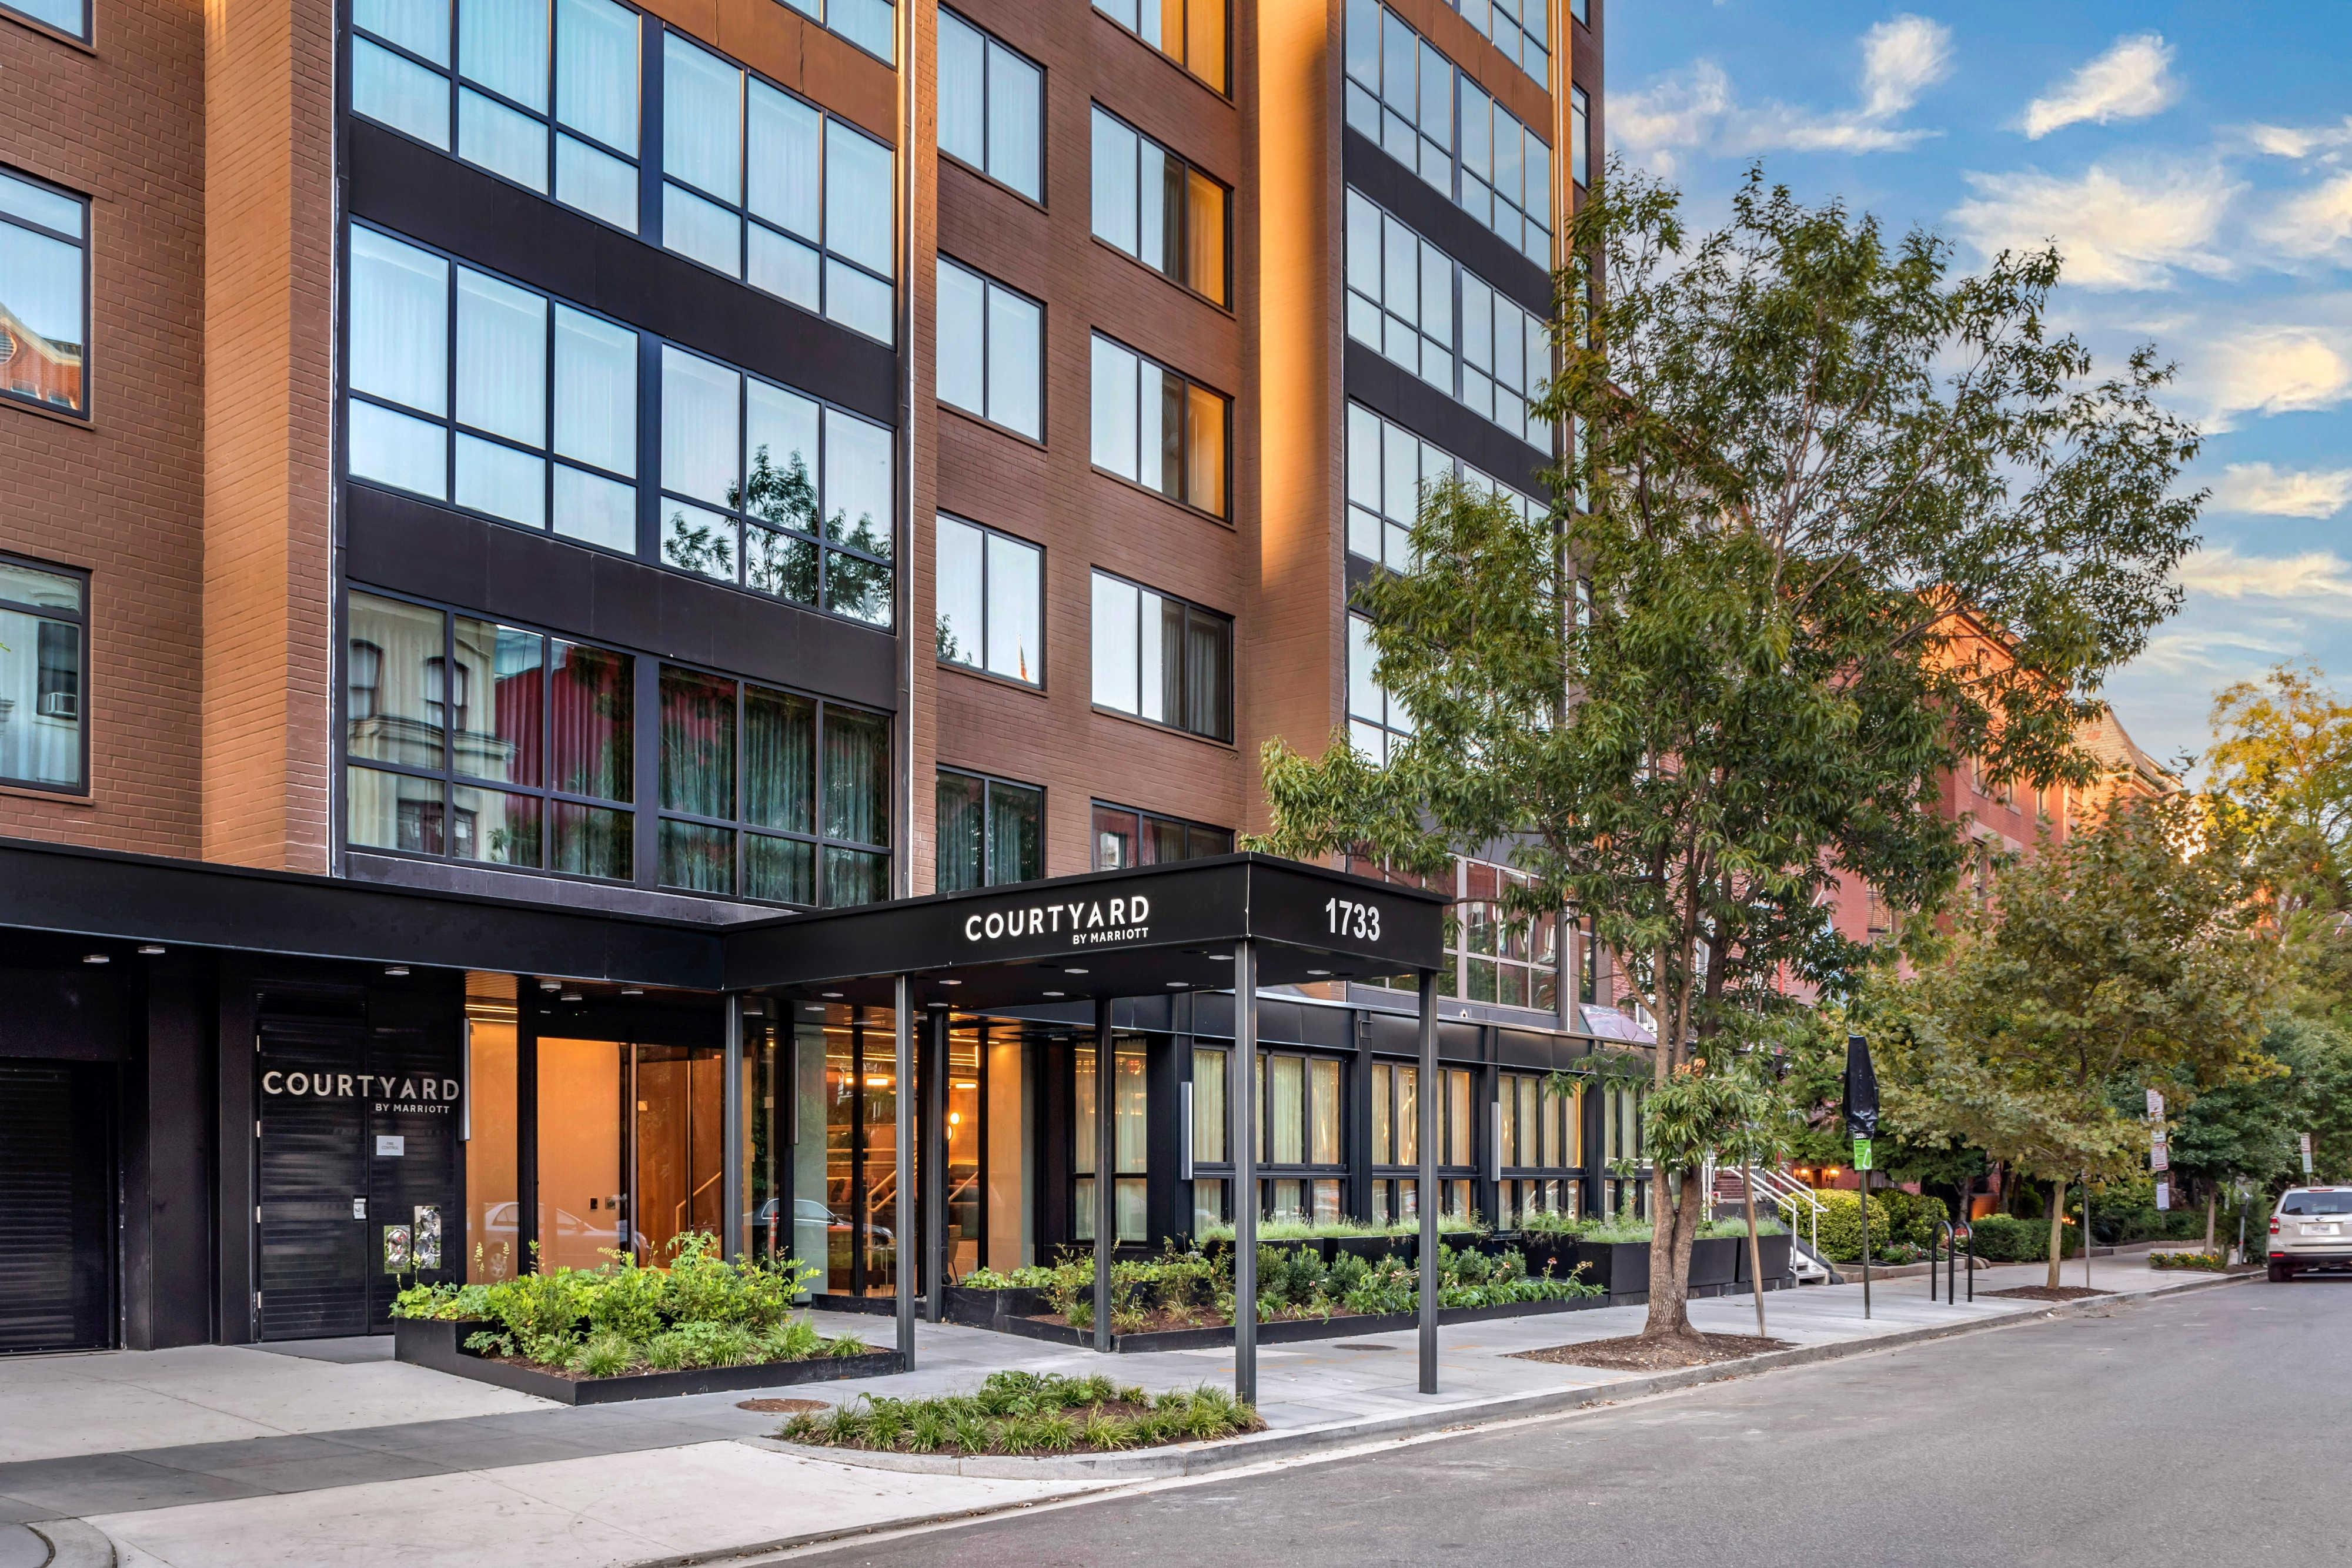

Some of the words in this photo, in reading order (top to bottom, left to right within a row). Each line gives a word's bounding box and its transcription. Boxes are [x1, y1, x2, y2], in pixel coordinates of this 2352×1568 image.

[965, 895, 1150, 941] COURTYARD
[1325, 897, 1381, 941] 1733
[1073, 933, 1087, 945] BY
[1090, 927, 1149, 944] MARRIOTT
[262, 1071, 459, 1101] COURTYARD
[375, 1103, 389, 1112] BY
[393, 1104, 450, 1114] MARRIOTT
